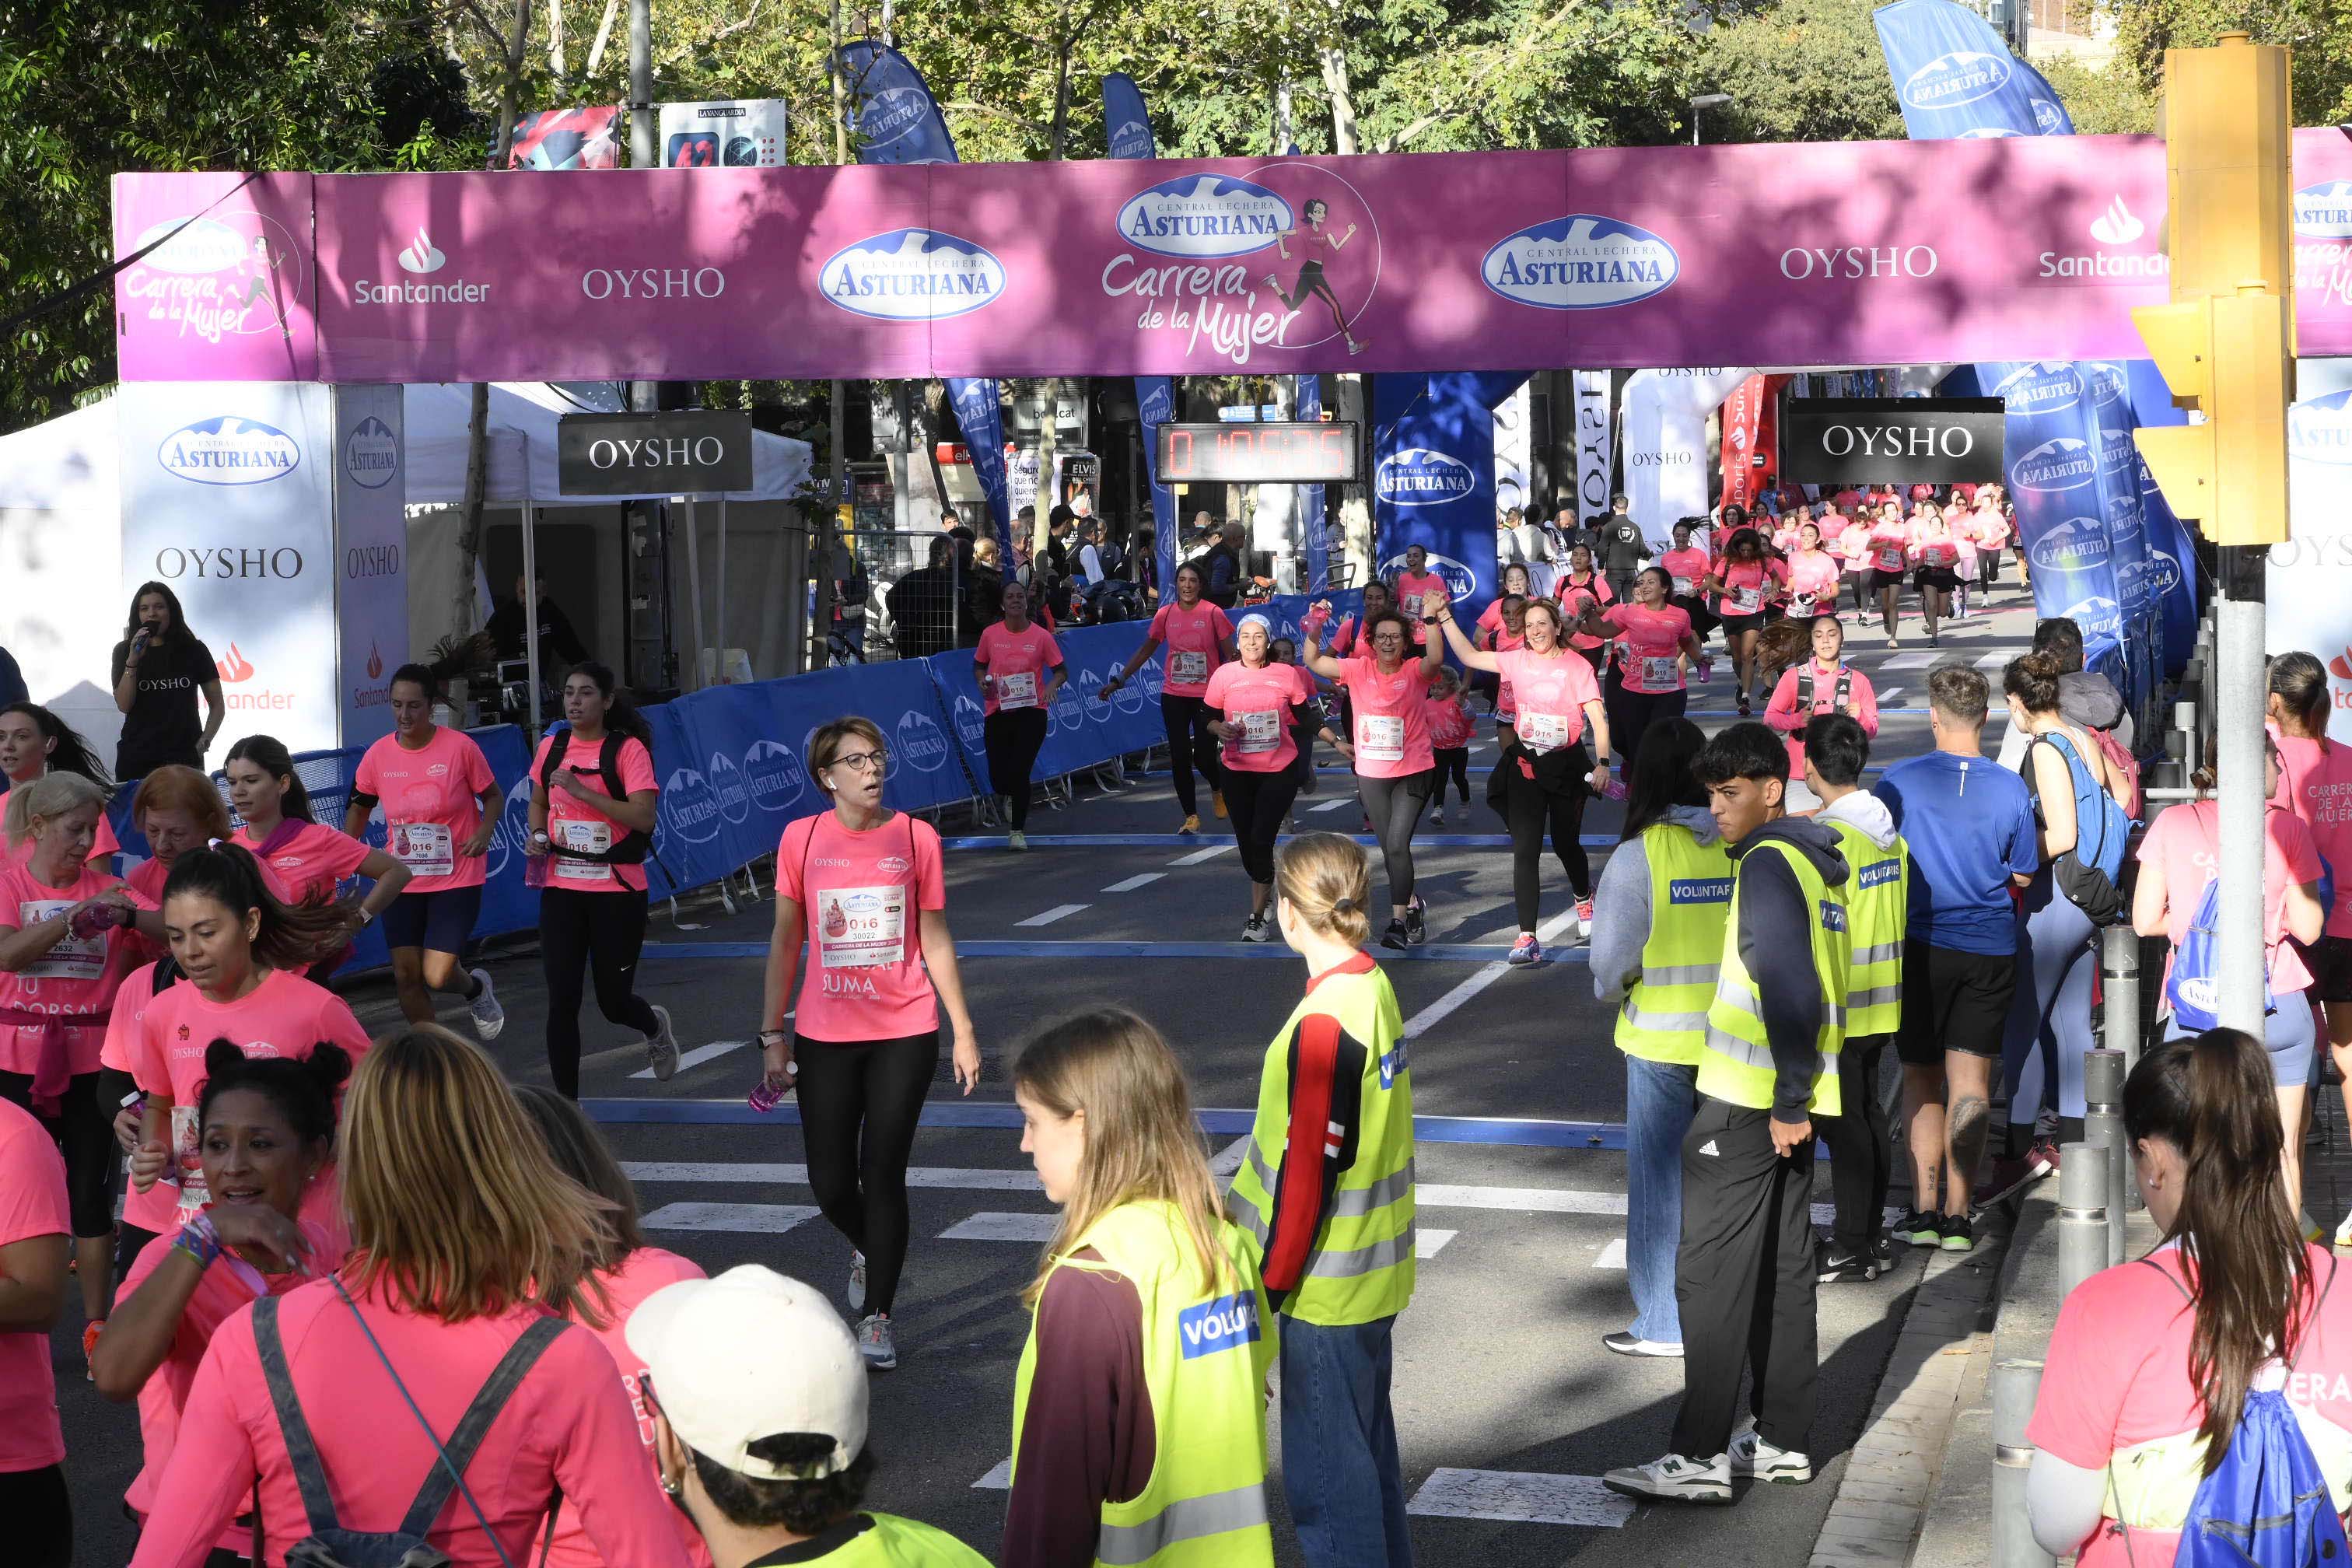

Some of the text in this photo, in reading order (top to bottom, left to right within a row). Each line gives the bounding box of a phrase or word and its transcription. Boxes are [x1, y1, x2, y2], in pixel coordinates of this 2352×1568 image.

[707, 108, 745, 117] VANGUARDIA
[1157, 201, 1275, 212] CENTRAL LECHERA
[1130, 206, 1280, 237] ASTURIANA
[1528, 247, 1657, 258] CENTRAL LECHERA
[1780, 245, 1937, 280] OYSHO
[1496, 251, 1664, 286] ASTURIANA
[2039, 251, 2170, 278] Santand
[125, 268, 221, 299] Carrera
[581, 267, 726, 299] OYSHO
[834, 264, 992, 296] ASTURIANA
[1101, 254, 1248, 297] Carrera
[355, 278, 491, 305] Santander
[149, 295, 254, 344] de la Mujer
[1137, 291, 1303, 365] de la Mujer
[1033, 408, 1076, 419] bc.cat
[1579, 370, 1605, 508] OYSH
[1822, 425, 1974, 459] OYSHO
[170, 443, 291, 468] ASTURIANA
[349, 447, 394, 472] ASTURIANA
[589, 436, 724, 469] OYSHO
[1633, 451, 1692, 467] OYSHO
[1072, 464, 1096, 474] ELVIS
[1014, 487, 1039, 497] quiere
[1379, 471, 1468, 493] ASTURIANA
[347, 544, 398, 579] OYSHO
[2269, 535, 2352, 569] OYS
[156, 547, 303, 579] OYSHO
[138, 676, 191, 691] OYSHO
[354, 684, 392, 709] Santand
[749, 767, 803, 798] ASTURIANA
[2308, 782, 2352, 798] CARRER
[2319, 797, 2333, 810] DE
[411, 842, 432, 852] 016
[569, 842, 589, 852] 016
[814, 858, 850, 869] OYSHO
[1859, 863, 1900, 884] VOLUTARIS
[1671, 881, 1732, 898] VOLUNTAR
[849, 918, 878, 930] 016
[852, 932, 876, 940] 30022
[54, 944, 73, 953] 2632
[830, 954, 856, 962] OYSHO
[16, 974, 38, 995] TU
[822, 973, 877, 994] SUMA
[185, 1178, 208, 1187] CARRE
